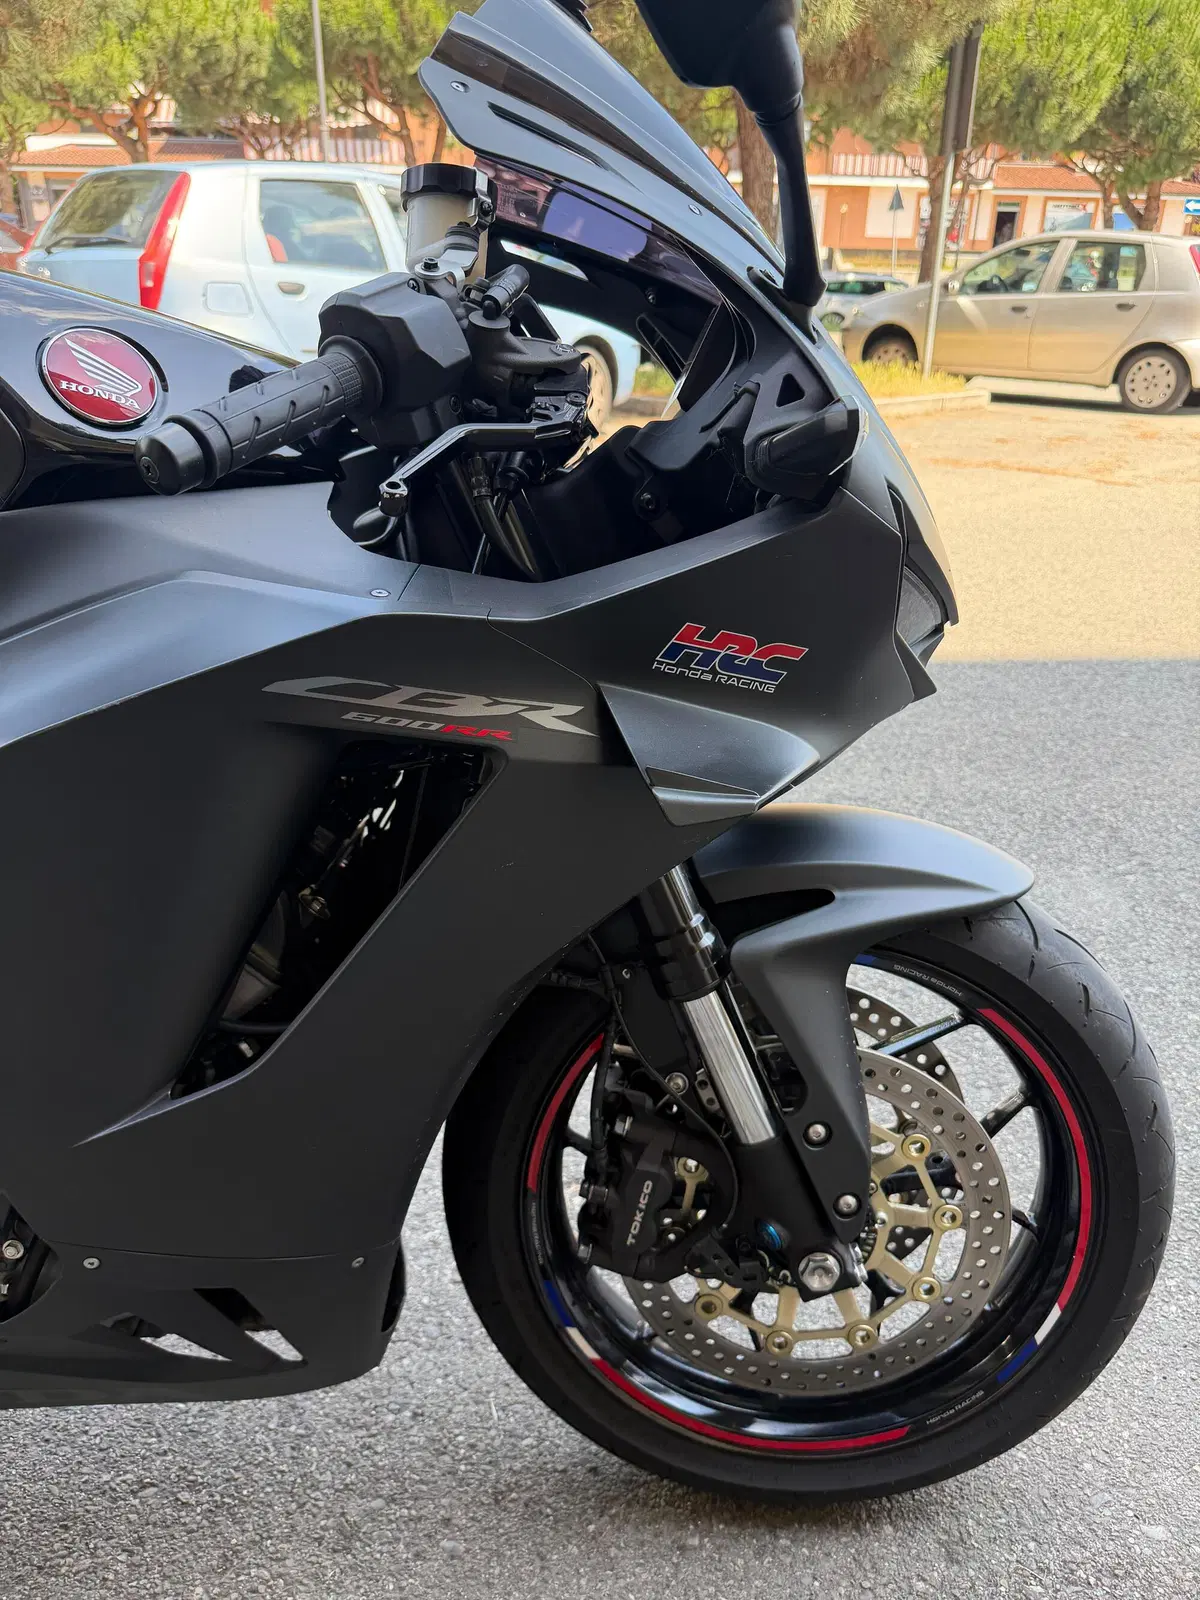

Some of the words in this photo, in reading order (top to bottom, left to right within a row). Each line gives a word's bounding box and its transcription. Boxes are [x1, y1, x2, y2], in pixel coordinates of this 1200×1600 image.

[60, 380, 141, 410] HONDA
[652, 661, 713, 681] Honda
[715, 674, 777, 693] RACING
[656, 622, 809, 684] HRC
[261, 676, 600, 737] CBR
[626, 1180, 653, 1246] TOKICO
